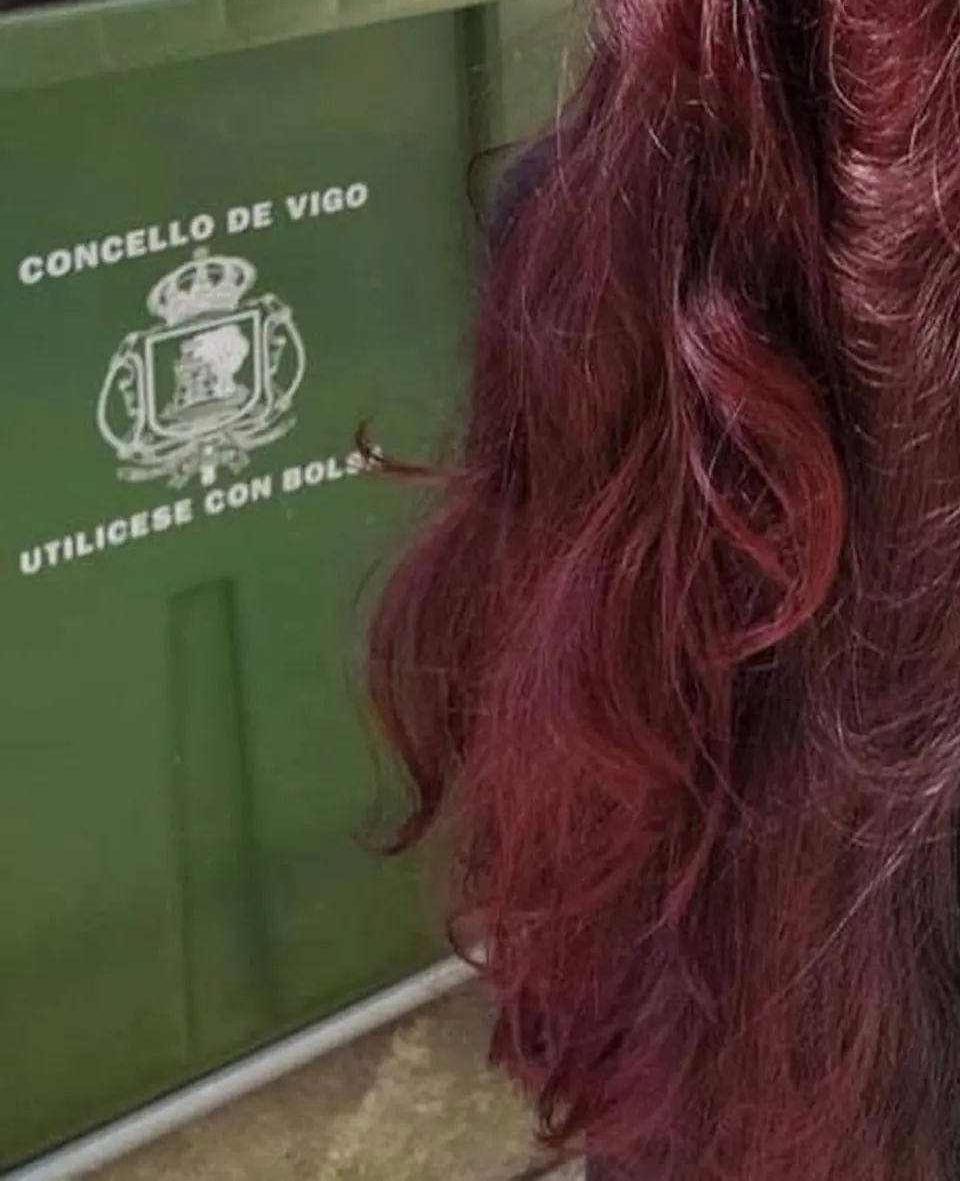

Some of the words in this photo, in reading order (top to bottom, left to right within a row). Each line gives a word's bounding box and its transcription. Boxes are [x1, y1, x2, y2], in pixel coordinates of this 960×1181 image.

[18, 213, 215, 286] CONCELLO
[226, 200, 274, 234] DE
[285, 182, 369, 221] VIGO
[19, 497, 194, 575] UTILICESE
[204, 474, 273, 515] CON
